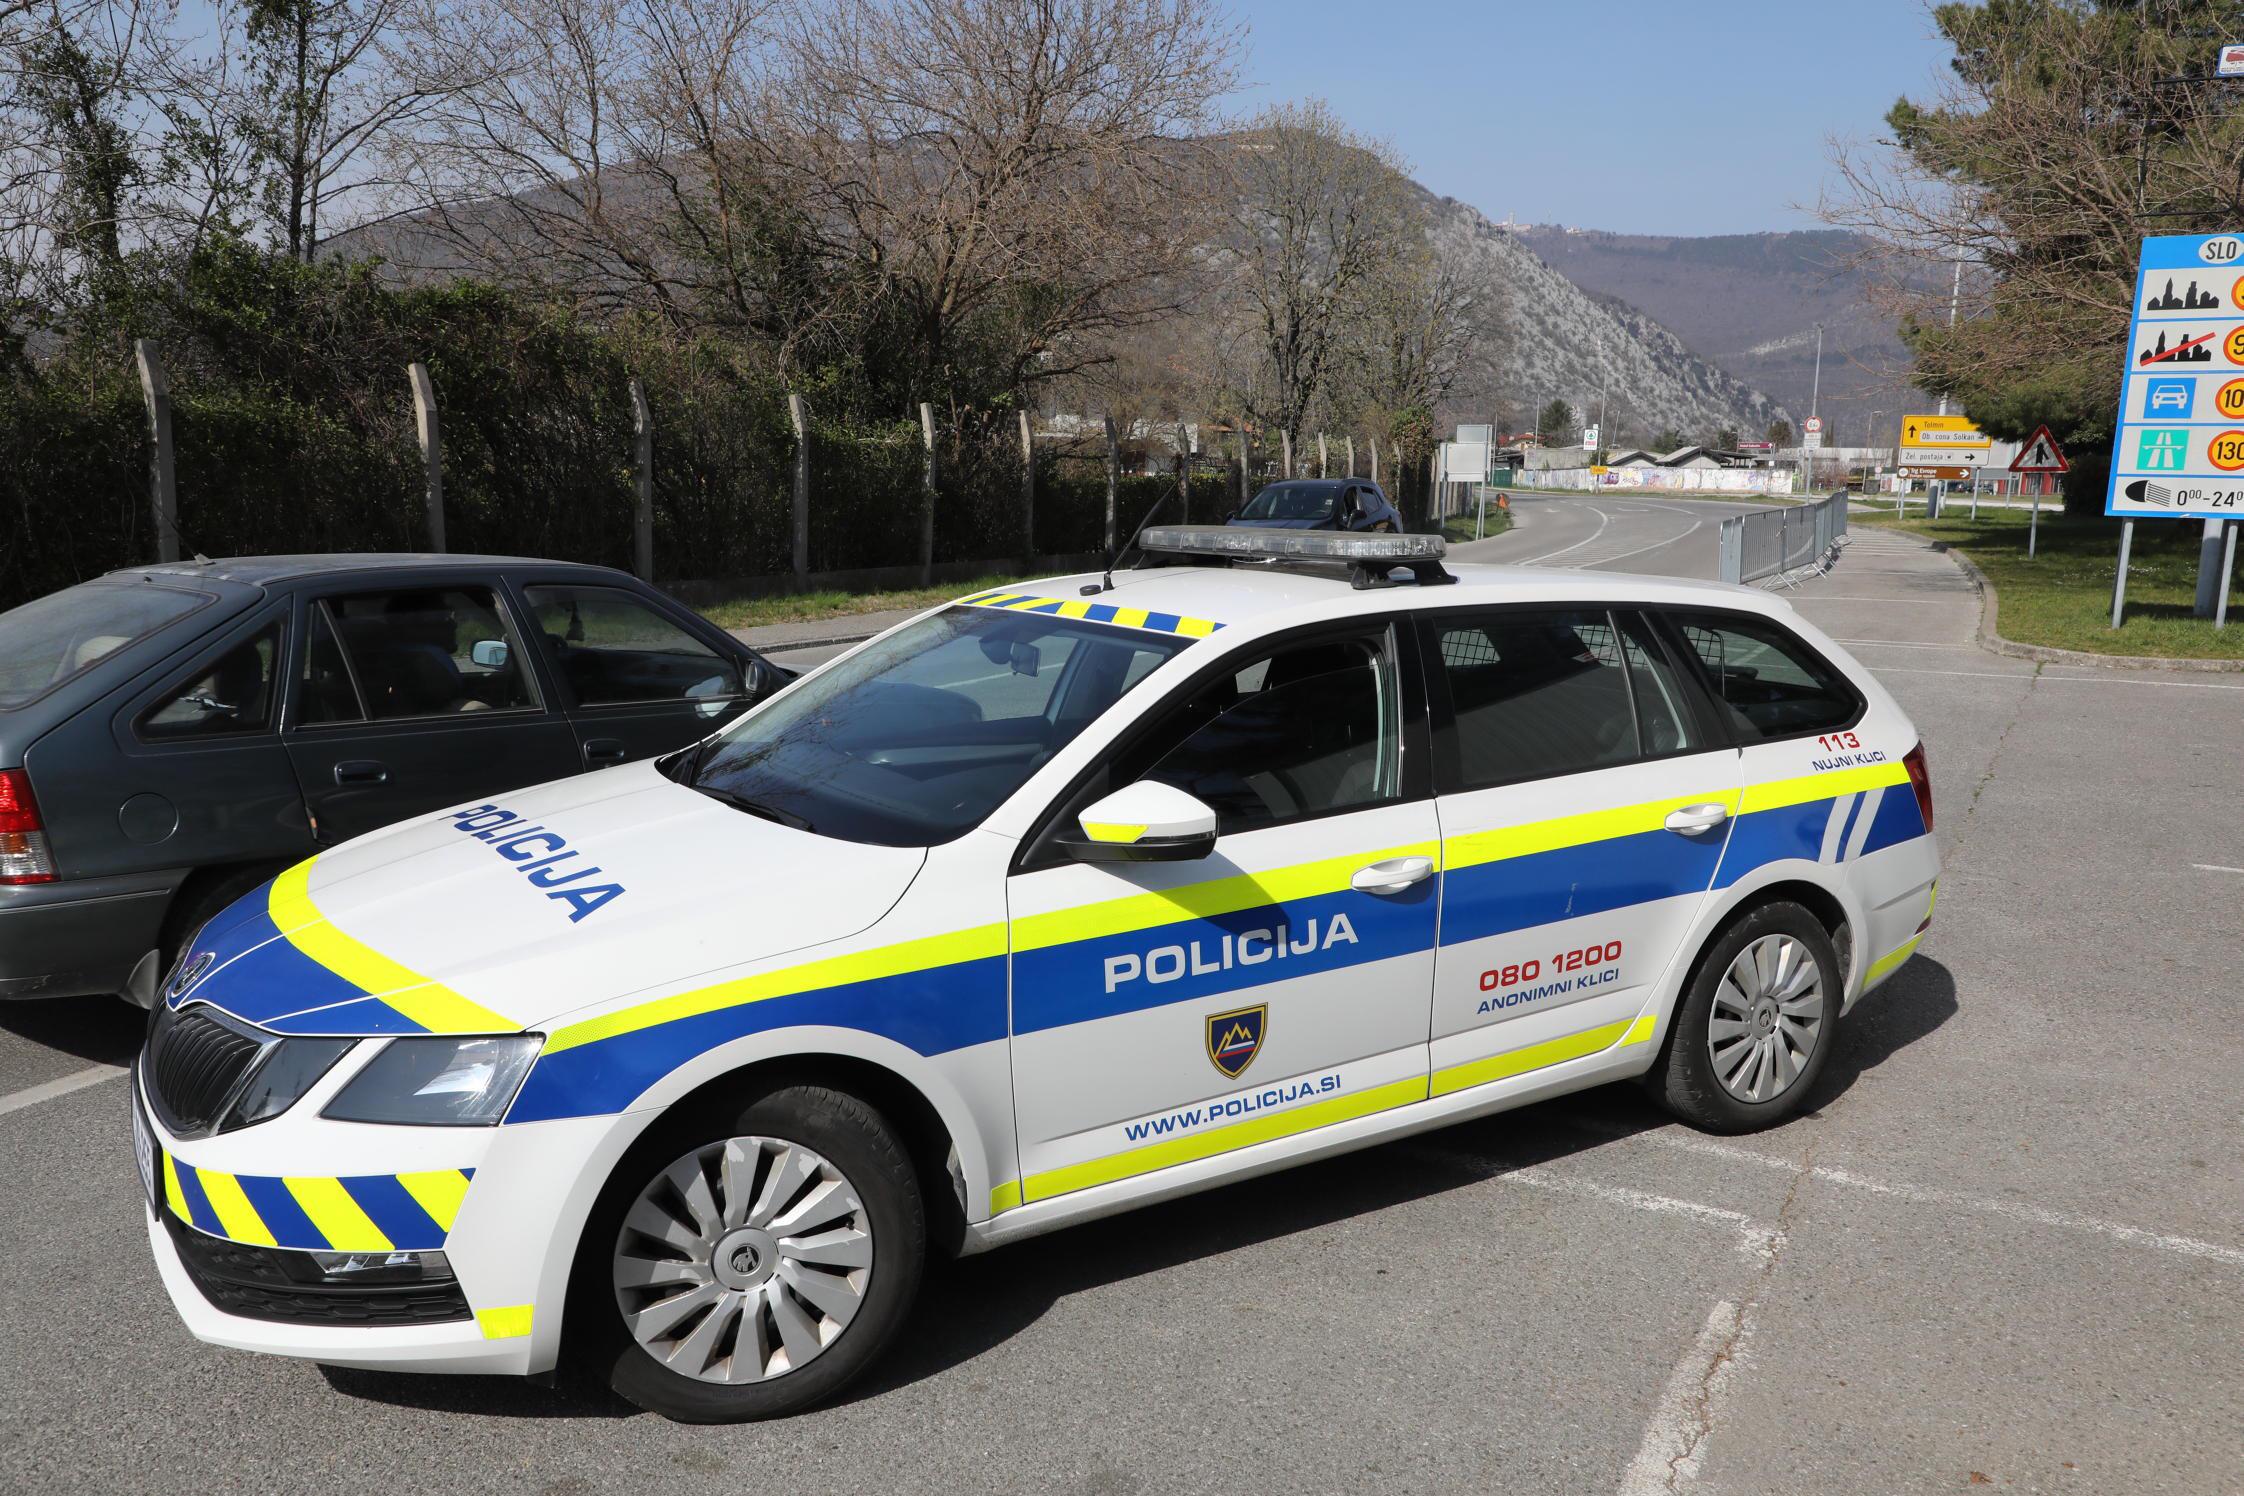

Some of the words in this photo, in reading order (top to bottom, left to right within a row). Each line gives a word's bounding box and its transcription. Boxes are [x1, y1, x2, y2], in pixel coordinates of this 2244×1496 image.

[2205, 241, 2237, 260] SLO
[1953, 432, 1975, 442] Solkan
[1812, 755, 1854, 771] NUJNI
[1854, 750, 1887, 765] KLICI
[1819, 732, 1860, 752] 113
[438, 804, 626, 924] POLICIJA
[1104, 913, 1359, 994] POLICIJA
[1479, 960, 1541, 992] 080
[1552, 940, 1622, 974] 1200
[1477, 980, 1572, 1014] ANONIMNI
[1577, 968, 1619, 990] KLICI
[1125, 1074, 1341, 1142] WWW.POLICIJA.SI
